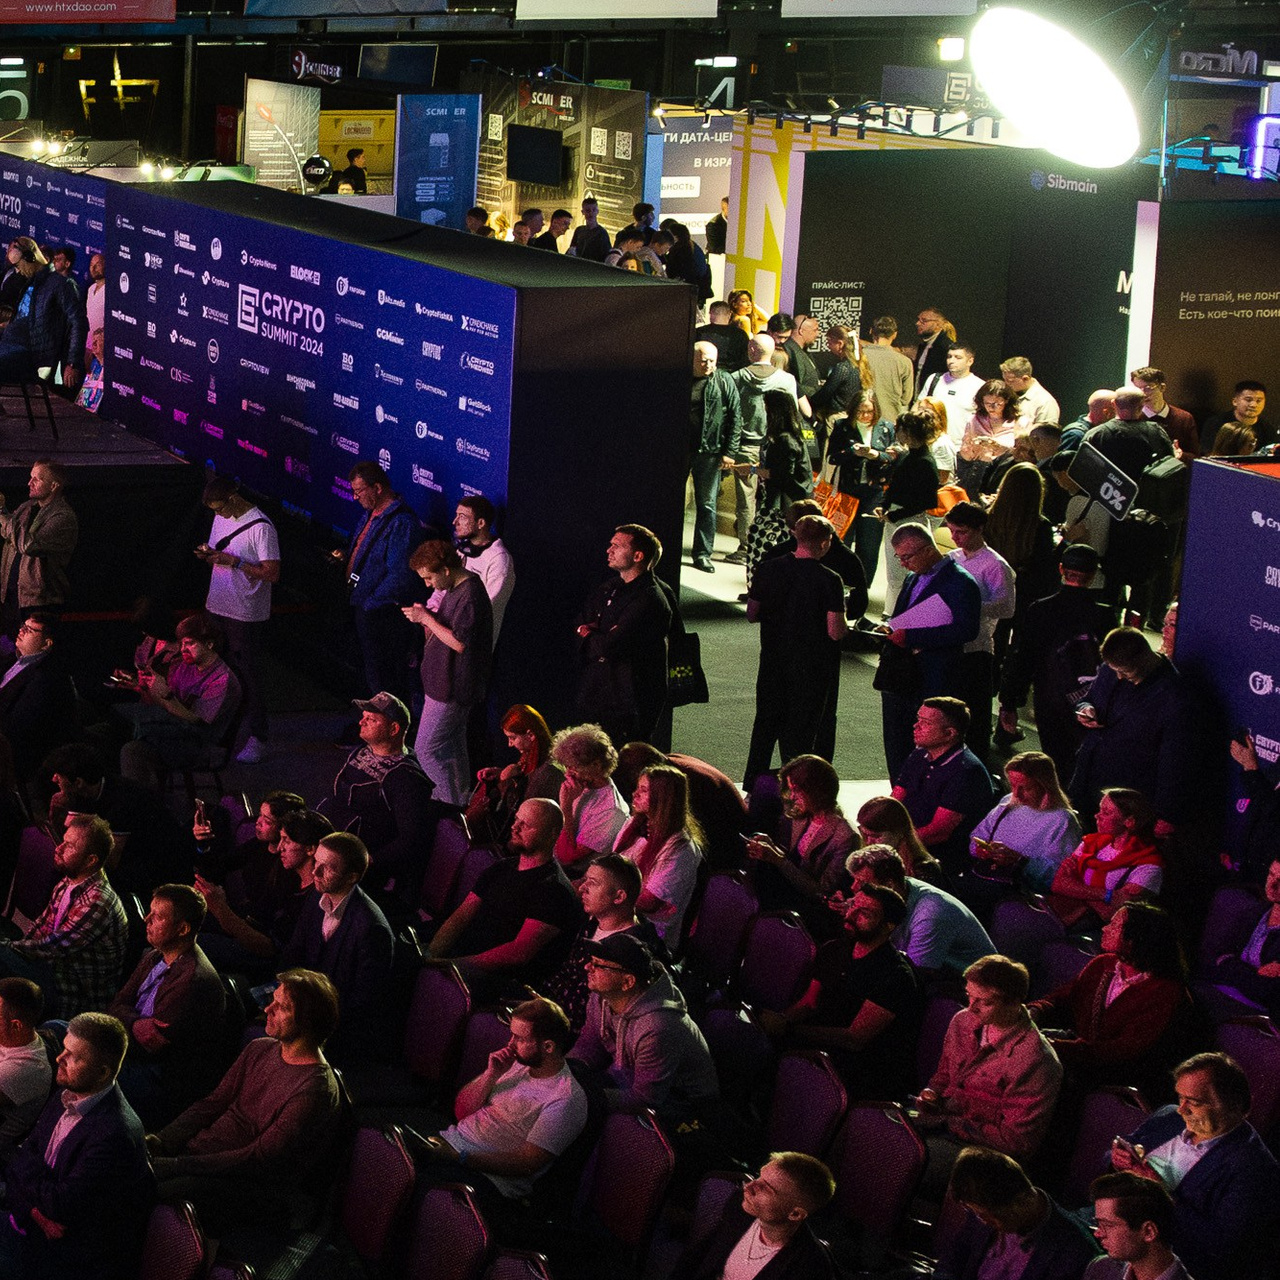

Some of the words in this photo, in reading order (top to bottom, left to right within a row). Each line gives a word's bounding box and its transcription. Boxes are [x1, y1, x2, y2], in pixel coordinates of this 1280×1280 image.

[25, 2, 117, 13] www.htxdao.com
[531, 91, 574, 109] SCMIER
[425, 106, 467, 117] SCMIER
[1047, 173, 1098, 194] Sibmain
[812, 281, 866, 290] ПРАЙС-ЛИСТ:
[1180, 291, 1196, 302] Не
[1198, 290, 1235, 303] тапай,
[1237, 292, 1252, 301] не
[261, 291, 326, 334] CRYPTO
[1179, 308, 1205, 320] Есть
[1207, 309, 1254, 320] кое-что
[261, 321, 299, 348] SUMMIT
[299, 335, 324, 358] 2024
[1099, 481, 1127, 511] 0%
